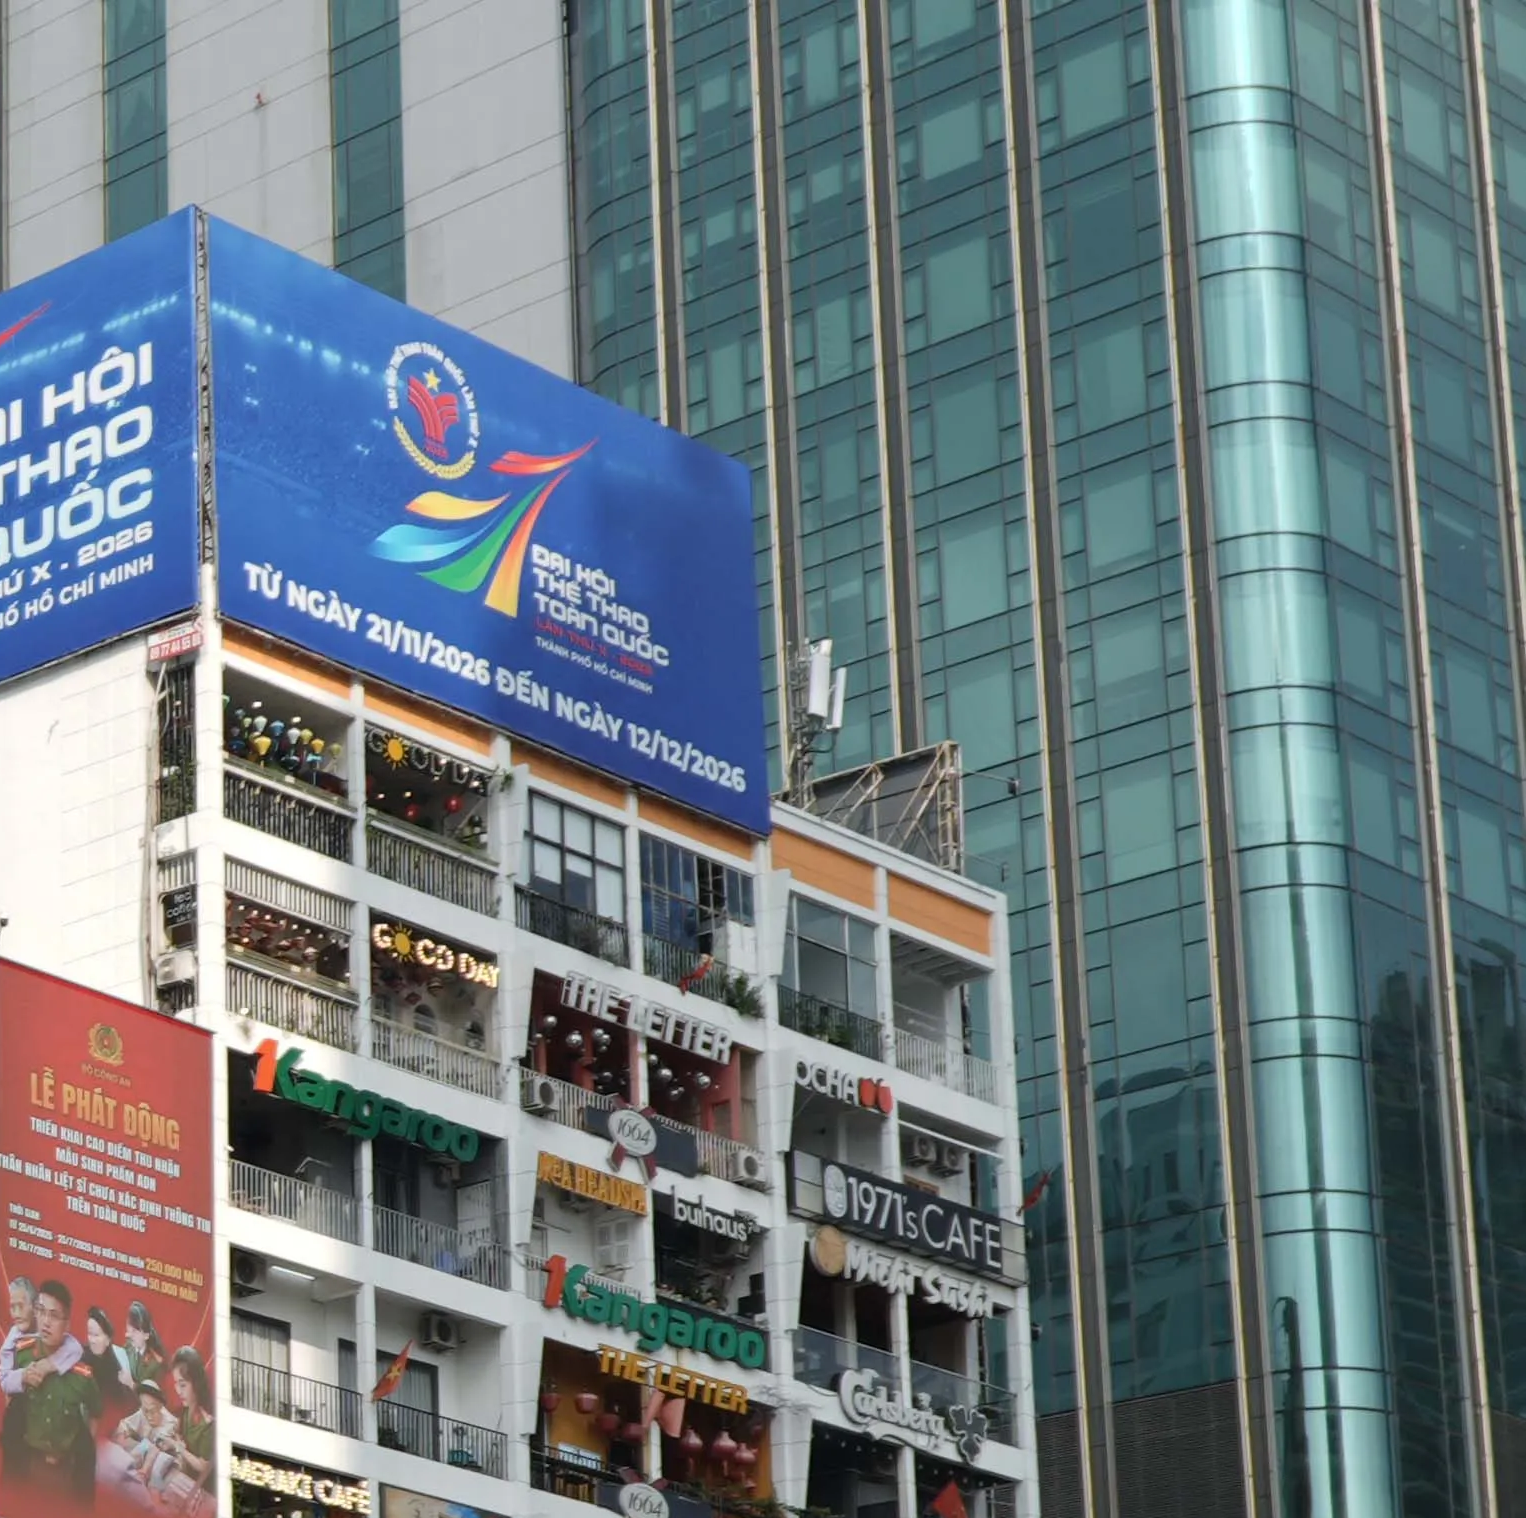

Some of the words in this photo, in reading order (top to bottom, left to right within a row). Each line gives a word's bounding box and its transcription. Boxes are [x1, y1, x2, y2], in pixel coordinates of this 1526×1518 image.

[42, 342, 152, 428] HỘI
[26, 588, 53, 619] HỒ
[59, 573, 94, 605] CHÍ
[100, 553, 153, 589] MINH
[31, 566, 51, 586] X
[78, 521, 153, 568] 2026
[532, 544, 570, 577] ĐẠI
[576, 563, 615, 597] HỘI
[533, 592, 598, 636] TOÀN
[602, 623, 669, 666] QUỐC
[586, 591, 649, 633] THAO
[244, 560, 281, 600] TỪ
[286, 580, 360, 633] NGÀY
[366, 611, 491, 686] 21/11/2026
[495, 665, 549, 716] ĐẾN
[556, 694, 625, 743] NGÀY
[627, 724, 748, 794] 12/12/2026
[457, 953, 501, 988] DAY
[561, 970, 629, 1023] THE
[627, 1000, 733, 1064] LETTER
[30, 1066, 55, 1110] LỄ
[62, 1083, 117, 1130] PHÁT
[123, 1101, 180, 1151] ĐỘNG
[617, 1117, 652, 1145] 1664
[849, 1177, 919, 1241] 1971's
[921, 1202, 1001, 1269] CAFE
[544, 1254, 765, 1369] Kangaroo
[598, 1344, 657, 1384] THE
[655, 1364, 748, 1416] LETTER
[840, 1368, 946, 1437] Carlsberg
